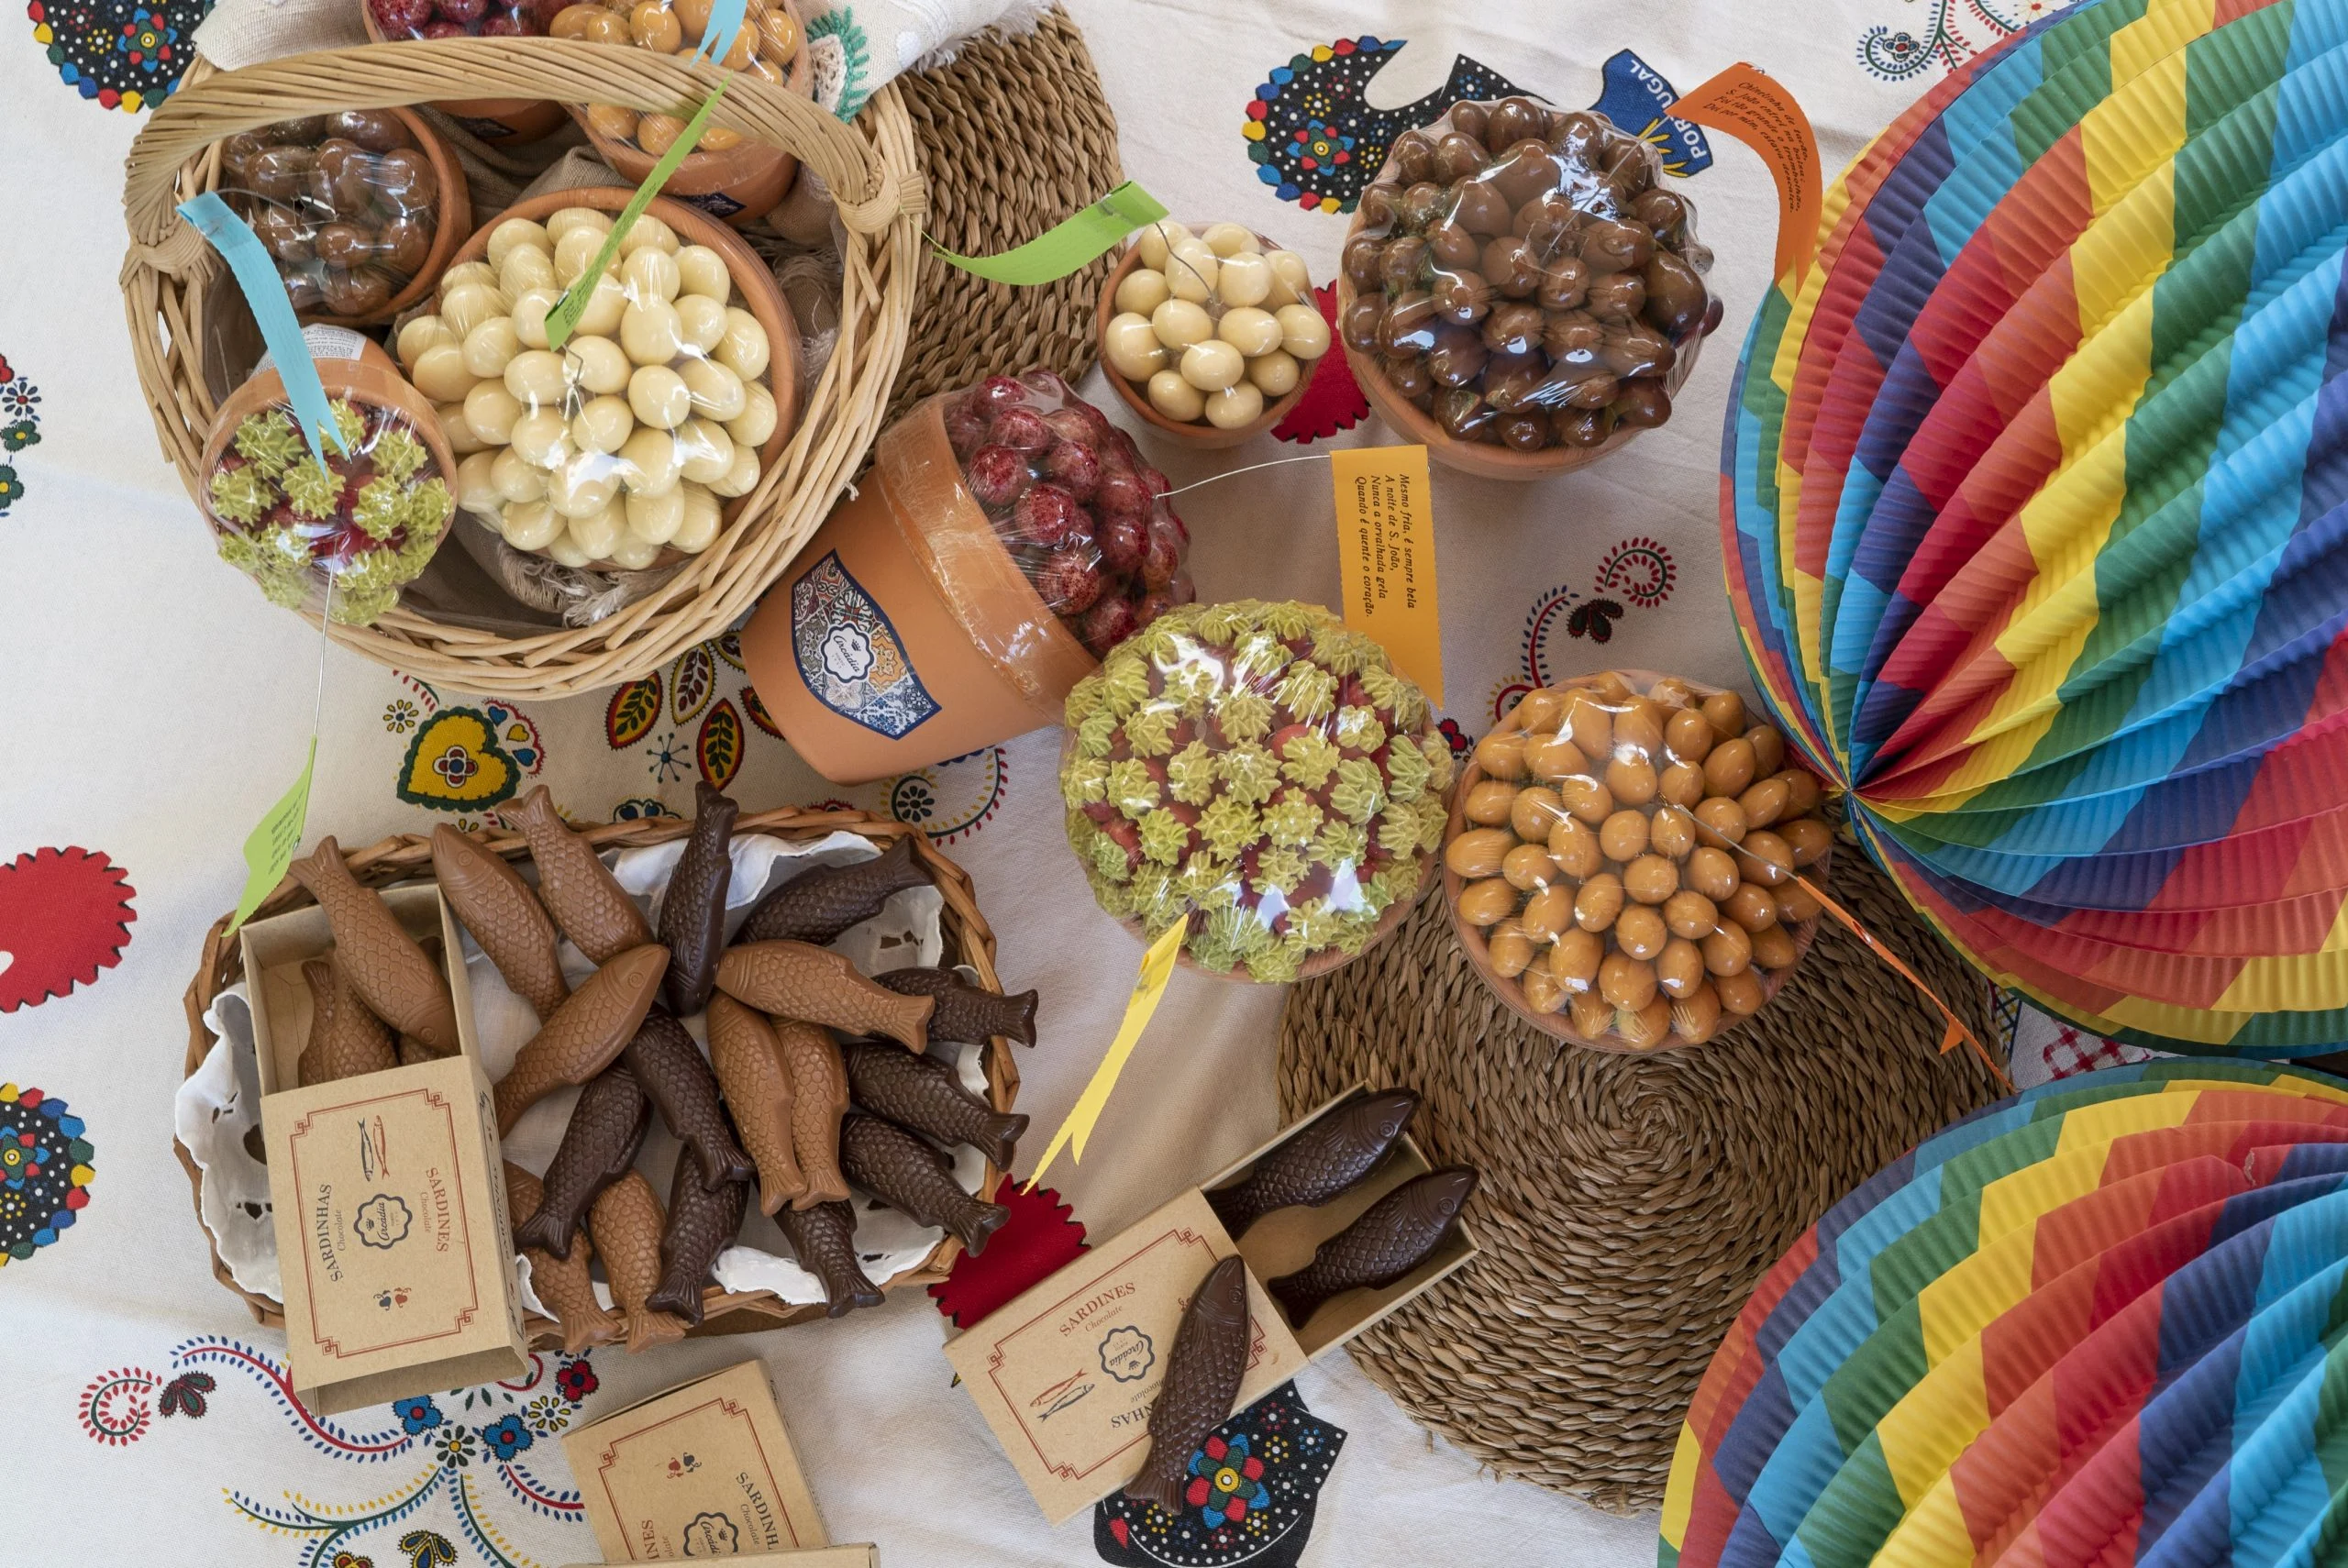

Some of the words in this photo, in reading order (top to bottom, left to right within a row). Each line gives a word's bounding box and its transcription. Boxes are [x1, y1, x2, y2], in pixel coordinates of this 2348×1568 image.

[1630, 60, 1707, 159] PORUGAL
[1745, 108, 1778, 134] grande
[1760, 105, 1787, 127] entrei
[1784, 130, 1794, 143] na
[1785, 114, 1795, 126] de
[1719, 107, 1739, 117] por
[1760, 131, 1784, 160] estava
[1355, 476, 1368, 514] Quando
[1371, 475, 1381, 506] Nunca
[1385, 474, 1395, 483] A
[1400, 474, 1410, 508] Mesmo
[1386, 487, 1397, 512] noite
[1389, 514, 1398, 526] de
[1390, 530, 1400, 542] S.
[1401, 510, 1412, 534] fria,
[1359, 528, 1371, 562] quente
[1374, 522, 1386, 573] orvalhada
[1389, 543, 1401, 571] João,
[1404, 547, 1414, 583] sempre
[1363, 576, 1375, 617] coração.
[1376, 576, 1388, 599] gela
[1407, 587, 1416, 609] bela
[834, 635, 860, 673] Arcádia
[376, 1201, 390, 1241] Arcádia
[420, 1192, 432, 1233] Chocolate
[426, 1167, 450, 1252] SARDINES
[316, 1184, 344, 1282] SARDINHAS
[335, 1209, 346, 1252] Chocolate
[1058, 1282, 1136, 1337] SARDINES
[1085, 1305, 1124, 1332] Chocolate
[1109, 1340, 1145, 1367] Arcádia
[1130, 1377, 1166, 1403] hocolate
[736, 1472, 780, 1551] SARDINH
[740, 1503, 760, 1545] Chocolate
[642, 1519, 659, 1560] INES
[701, 1521, 721, 1555] Arcádi
